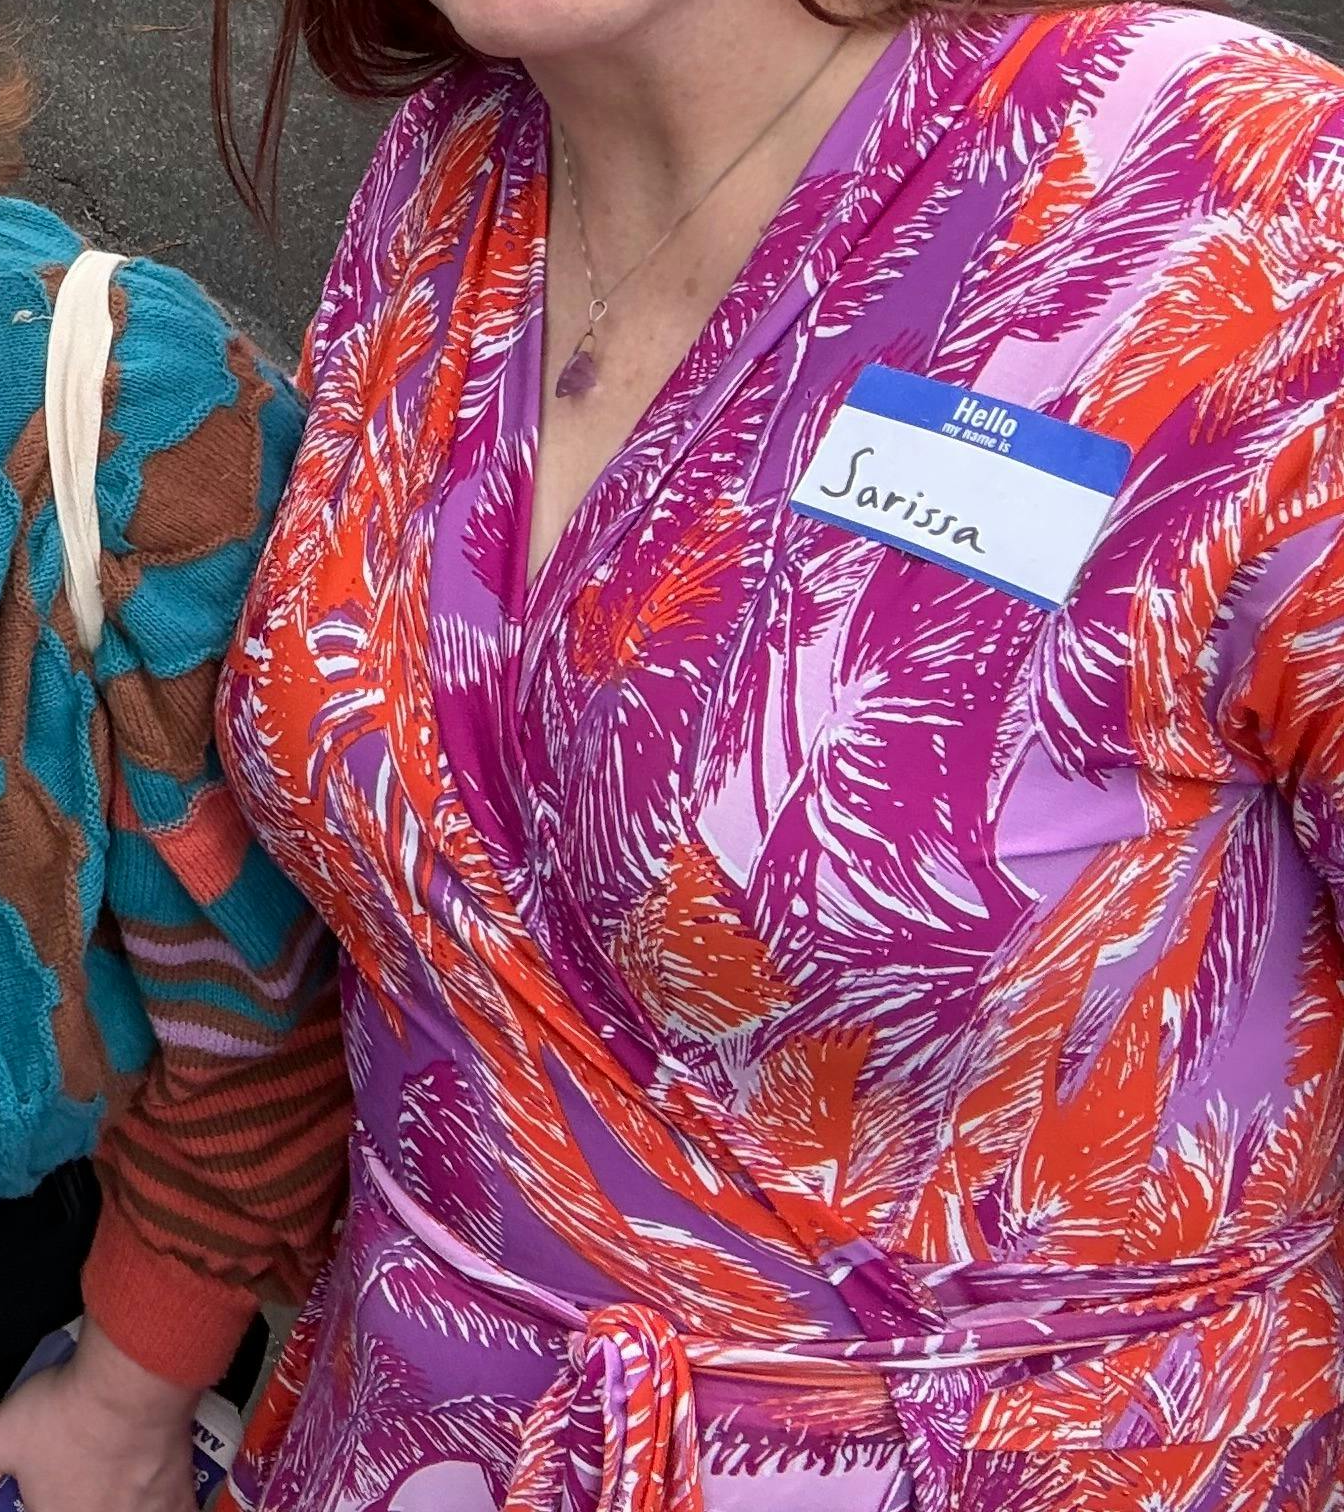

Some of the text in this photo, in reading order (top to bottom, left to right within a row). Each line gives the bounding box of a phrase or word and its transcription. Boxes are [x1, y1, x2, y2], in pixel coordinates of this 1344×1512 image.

[941, 422, 1012, 455] my name is
[951, 396, 1019, 439] Hello
[819, 446, 987, 555] Sarissa
